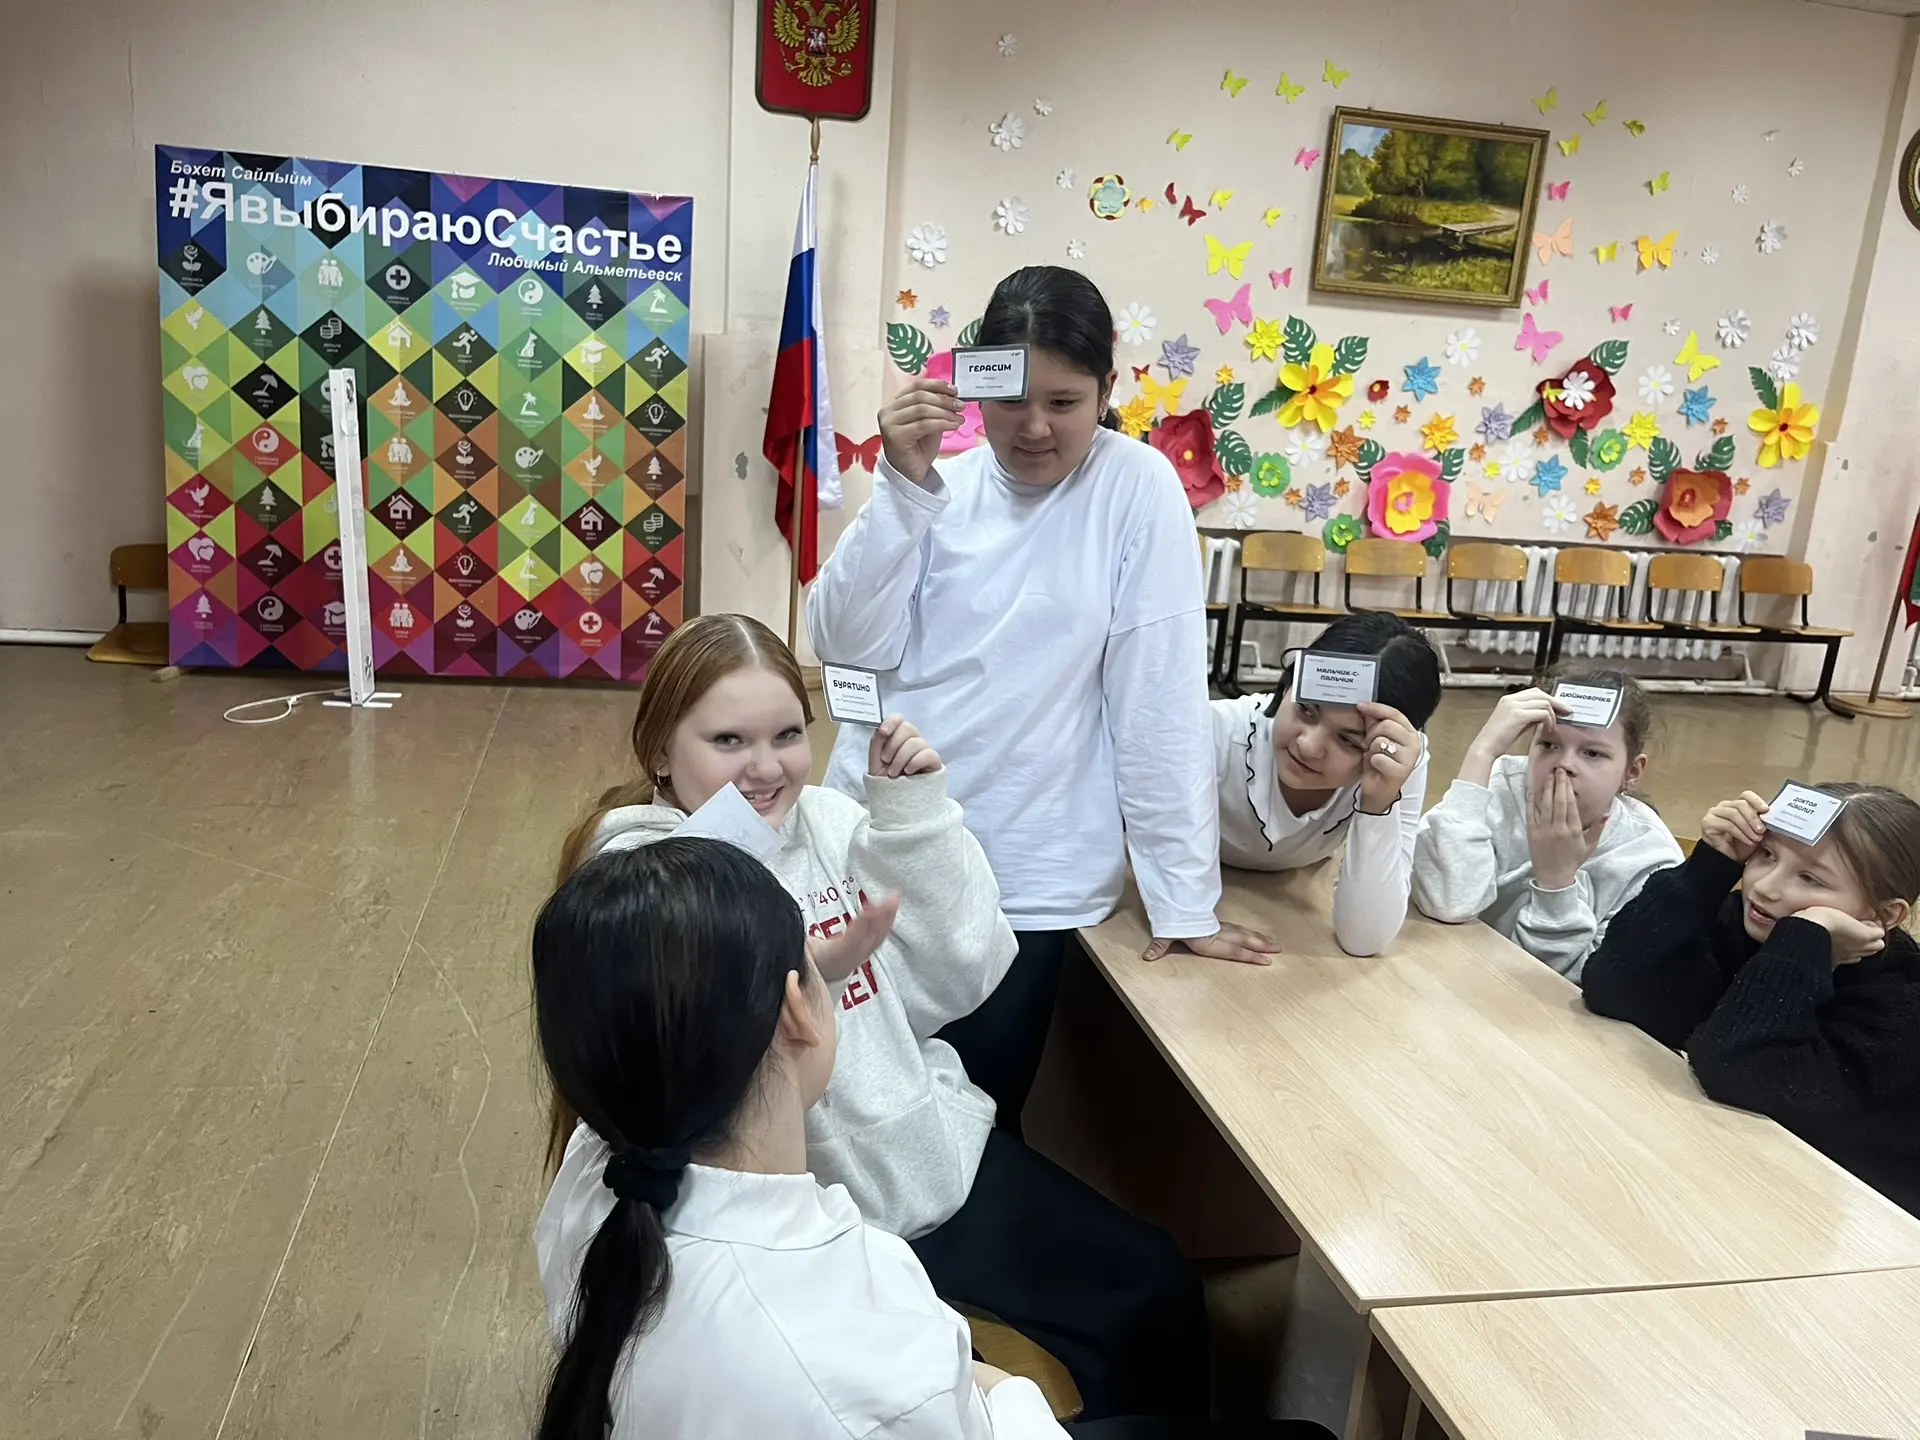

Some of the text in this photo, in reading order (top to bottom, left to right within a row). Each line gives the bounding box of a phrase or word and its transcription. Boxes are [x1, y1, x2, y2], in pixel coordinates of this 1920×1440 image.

[170, 160, 313, 187] Бәхет Сайлыйм
[168, 177, 682, 264] #ЯвыбираюСчастье
[487, 252, 683, 282] Любимый Альметьевск
[968, 363, 1012, 373] ГЕРАСИМ
[833, 679, 871, 693] БУРАТИНО
[1320, 675, 1354, 683] ПАЛЬЧИК
[1559, 692, 1611, 703] ДЮЙМОВОЧКА
[1792, 796, 1818, 807] ДОКТОР
[1787, 802, 1815, 816] АЙБОЛИТ
